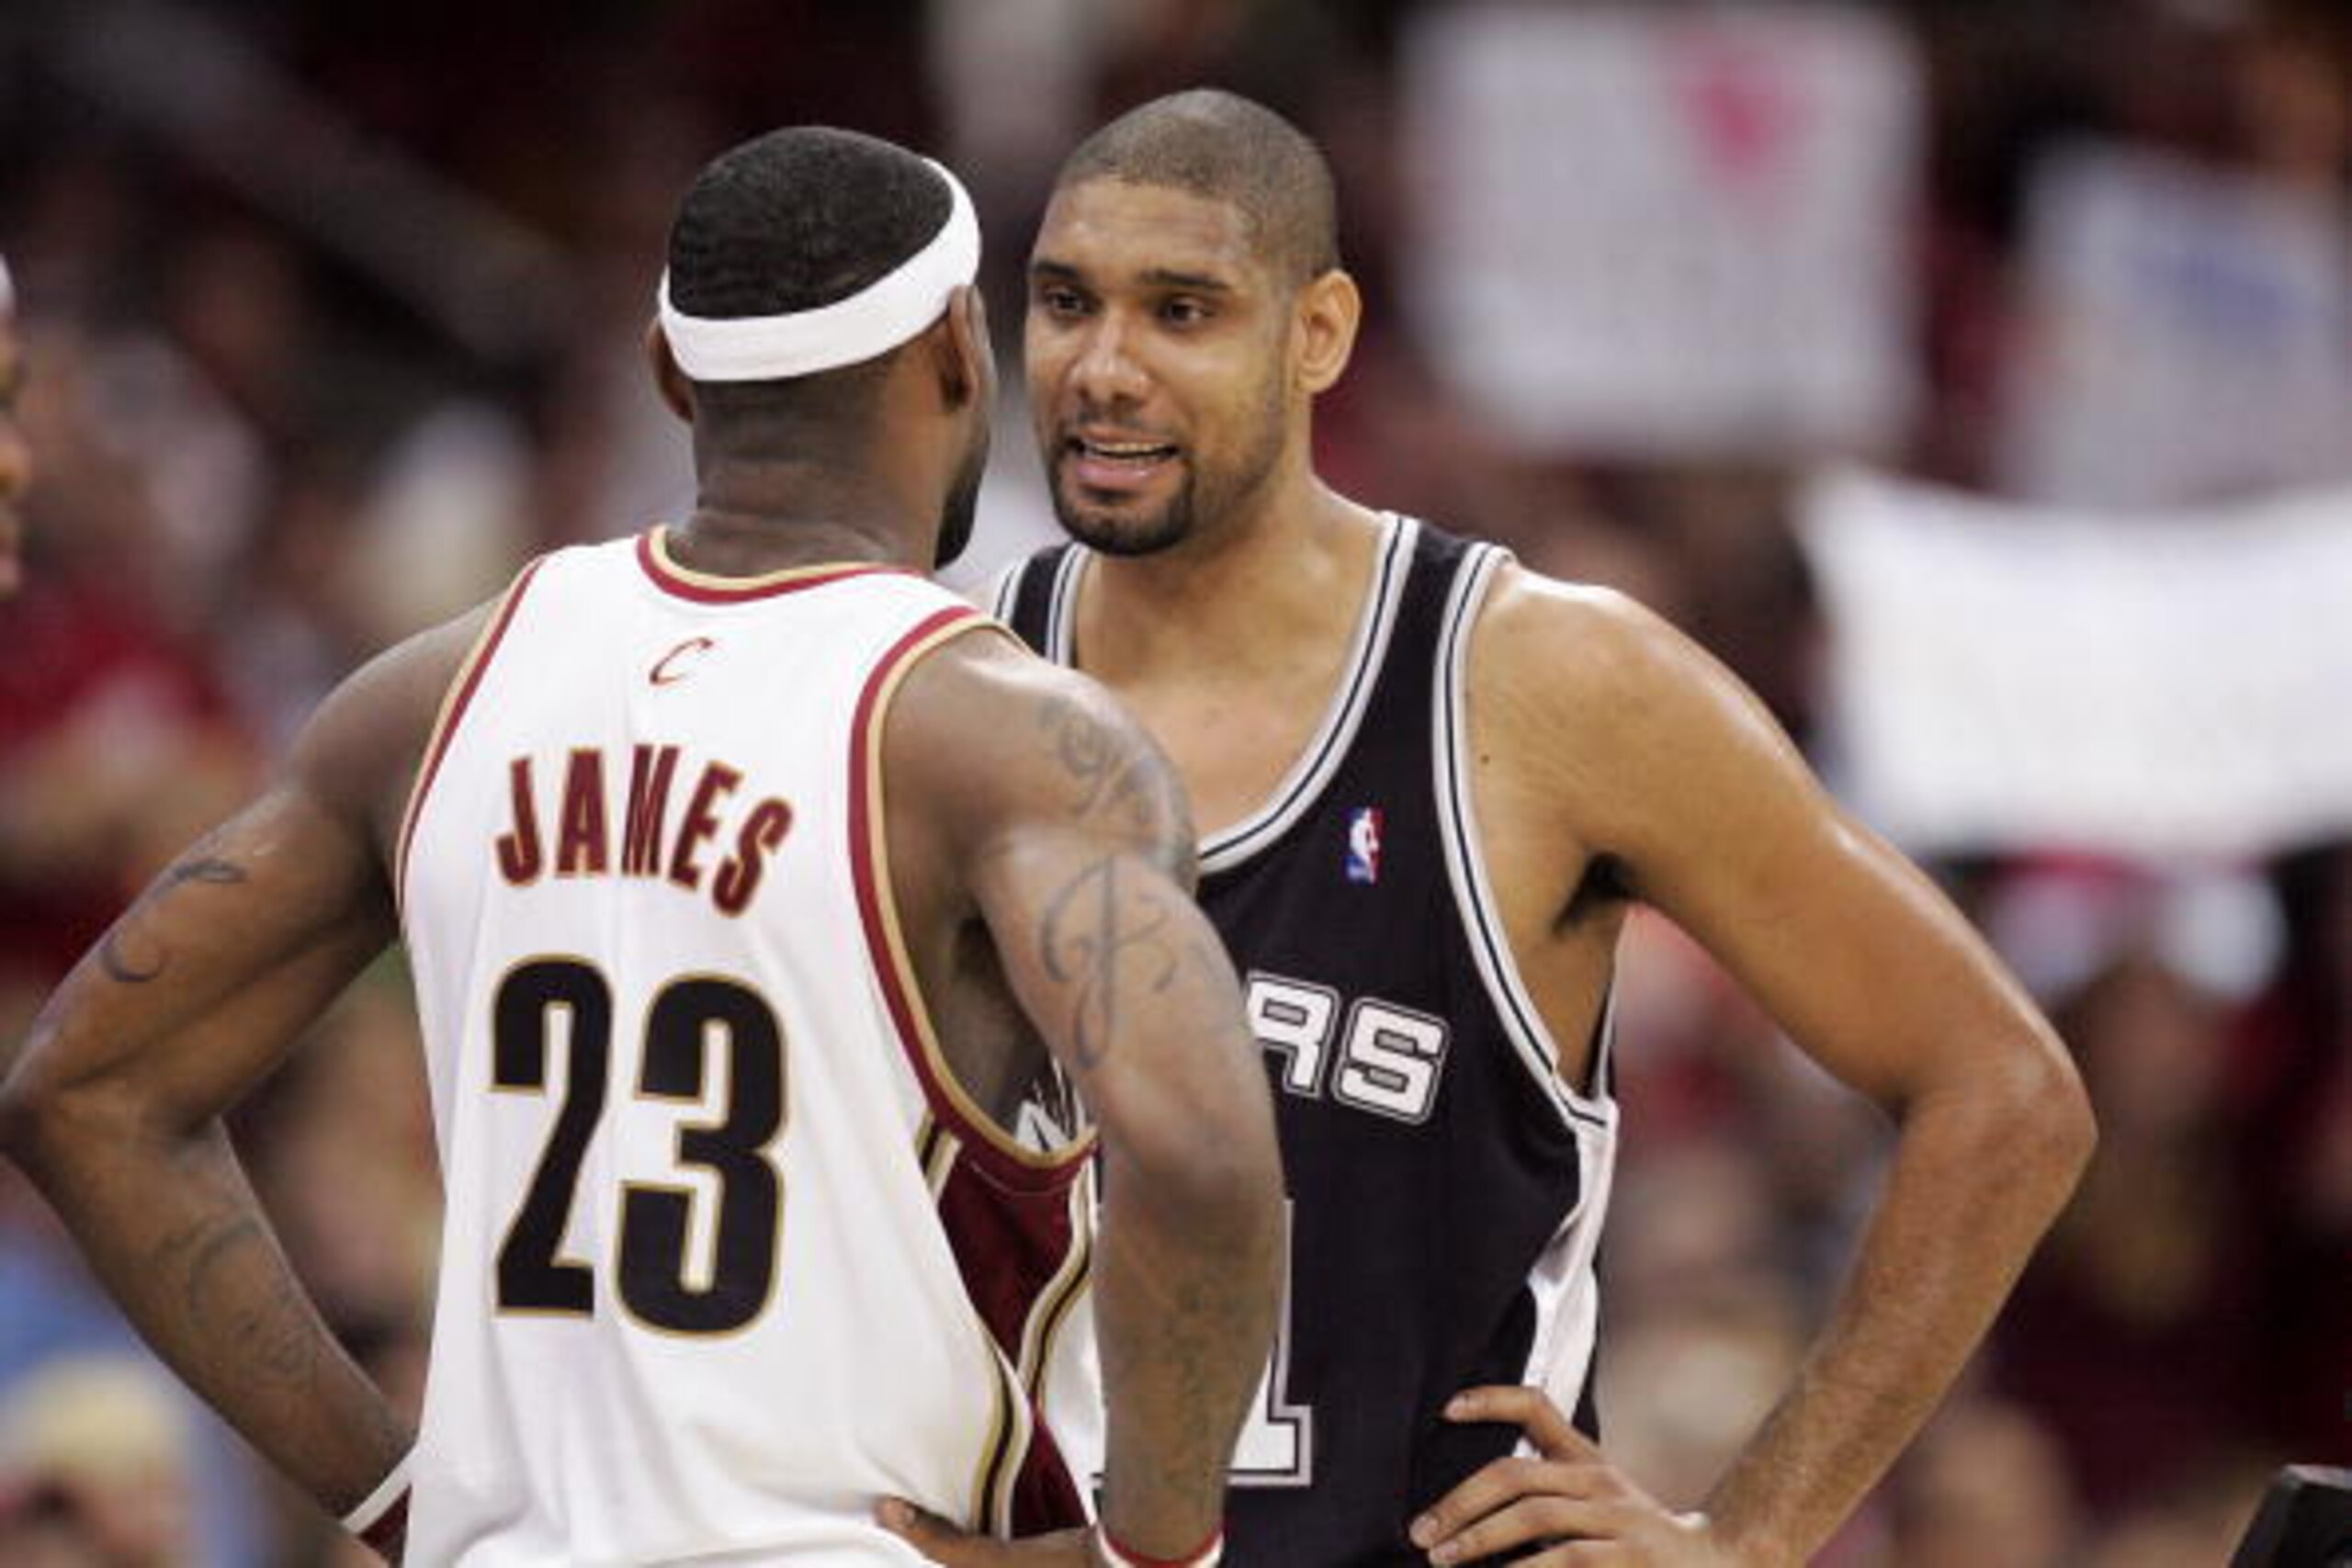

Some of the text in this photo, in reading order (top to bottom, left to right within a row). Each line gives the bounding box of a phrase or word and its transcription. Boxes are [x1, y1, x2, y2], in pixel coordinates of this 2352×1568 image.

[495, 744, 794, 918] JAMES
[1247, 969, 1450, 1125] RS
[489, 953, 788, 1339] 23
